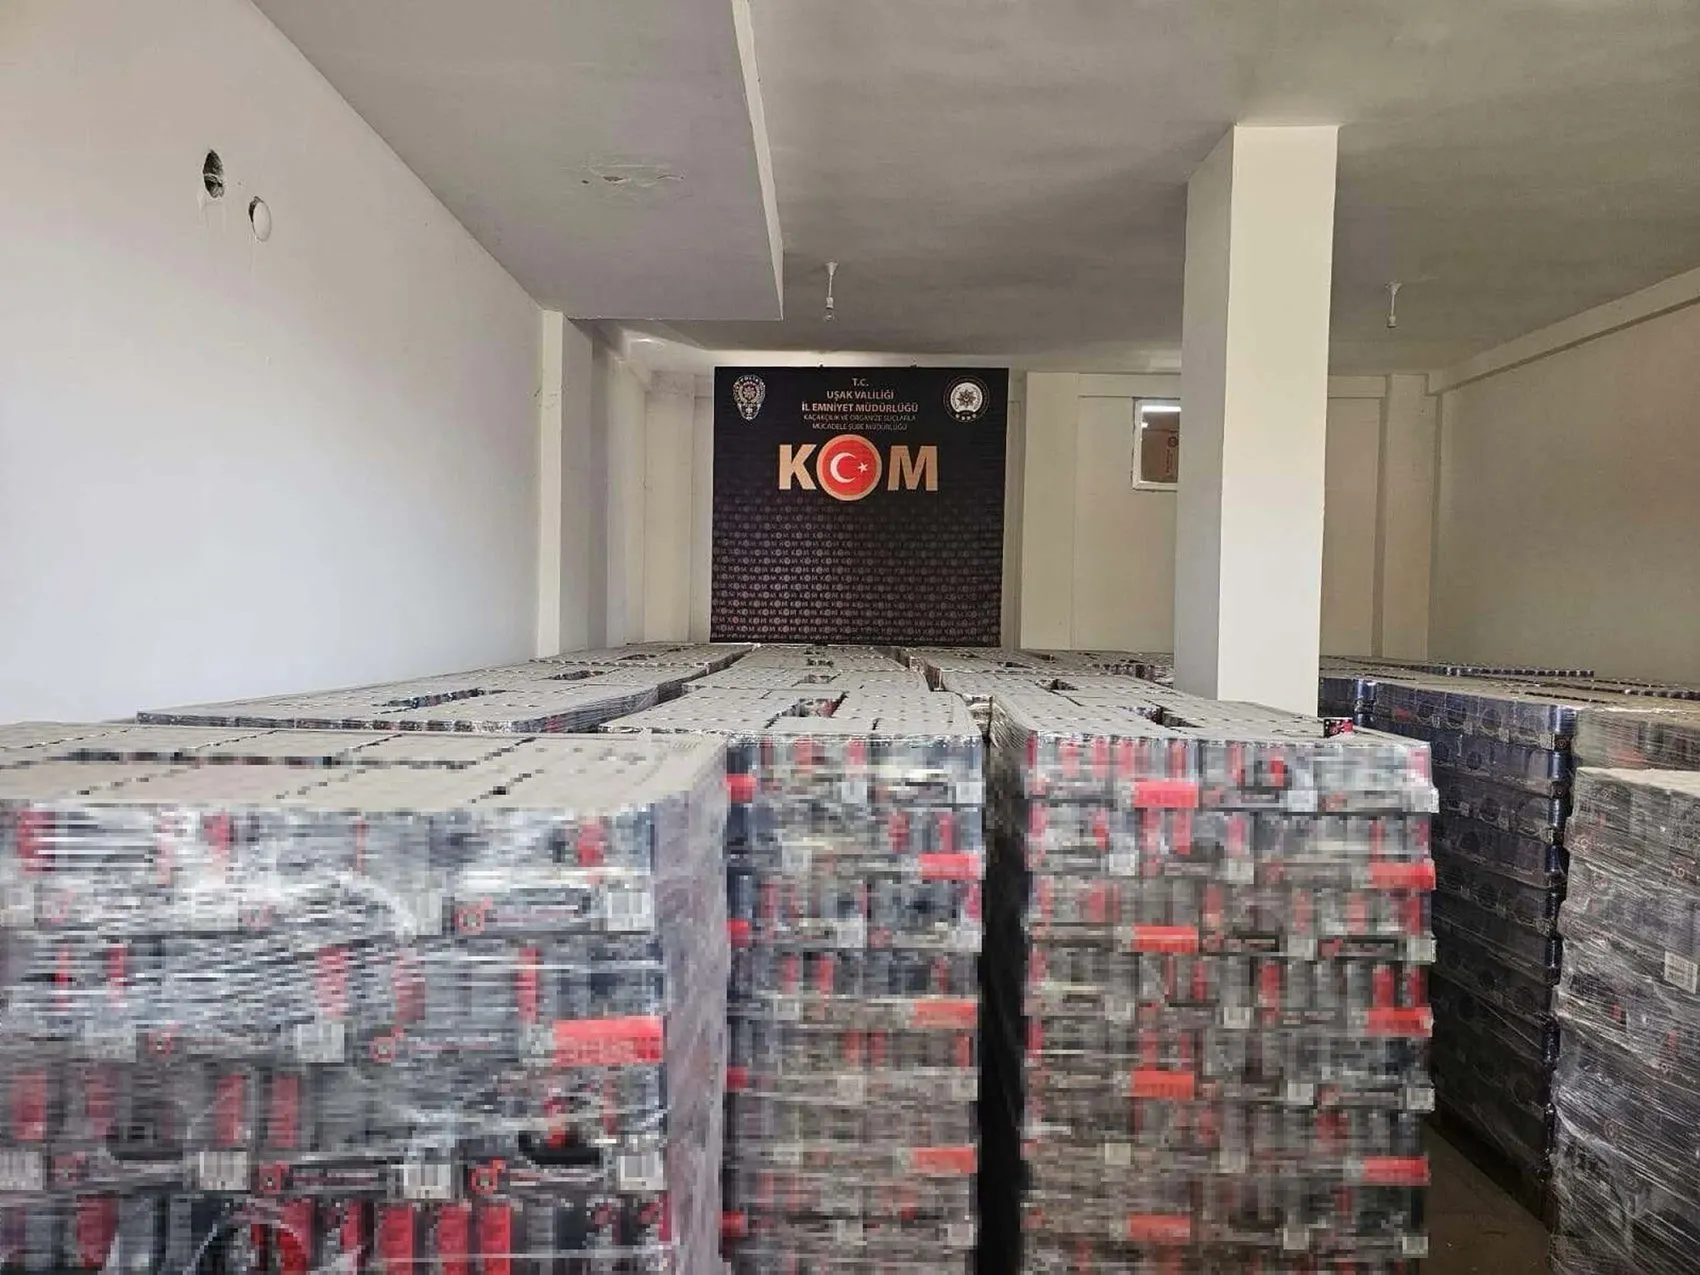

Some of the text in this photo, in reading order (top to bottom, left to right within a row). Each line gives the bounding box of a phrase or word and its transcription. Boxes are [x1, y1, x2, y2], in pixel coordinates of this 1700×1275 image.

[852, 378, 869, 387] T.C.
[826, 389, 894, 401] UŞAK VALİLİĞİ
[801, 402, 919, 413] İL EMNİYET MÜDÜRLÜĞÜ
[778, 434, 938, 502] KOM
